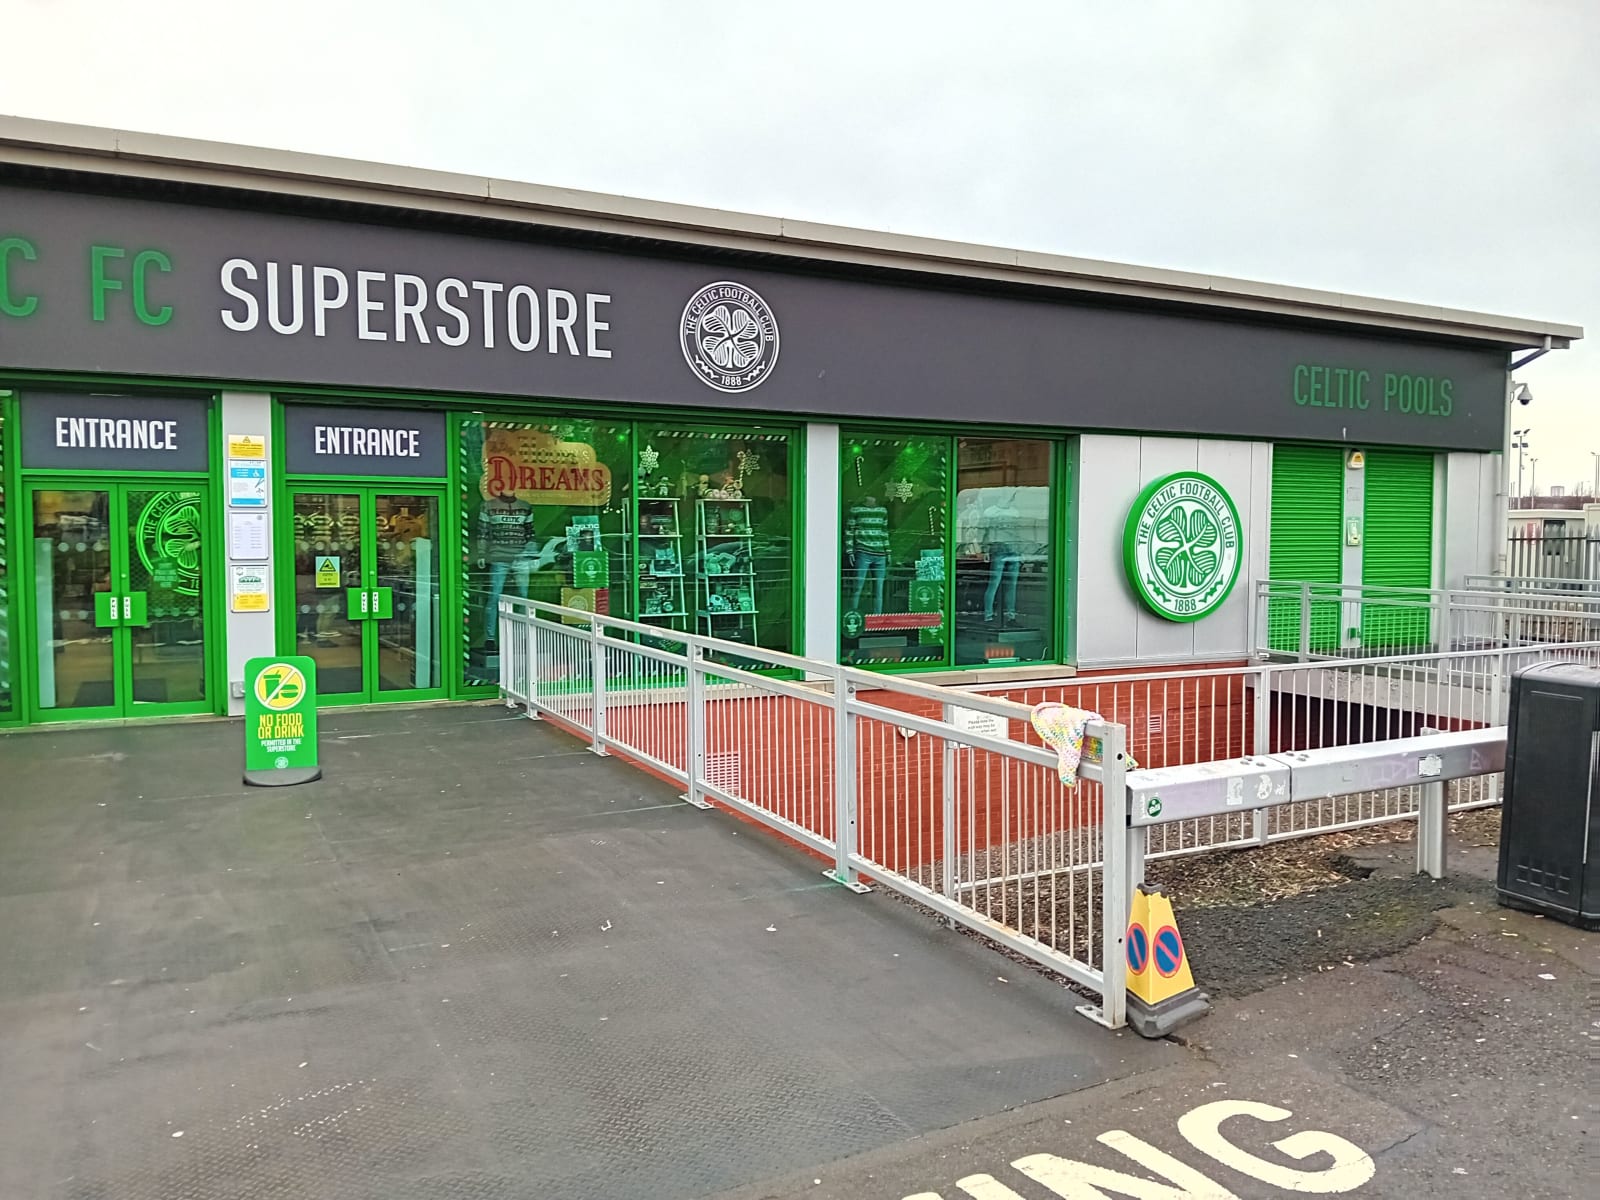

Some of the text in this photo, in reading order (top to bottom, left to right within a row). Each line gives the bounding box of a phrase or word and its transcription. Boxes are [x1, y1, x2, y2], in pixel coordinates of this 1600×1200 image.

[91, 245, 173, 326] FC
[220, 258, 612, 359] SUPERSTORE
[686, 287, 774, 342] THE CELTIC FOOTBALL CLUB
[721, 375, 742, 386] 1888
[1293, 364, 1453, 417] CELTIC POOLS
[55, 417, 178, 450] ENTRANCE
[314, 426, 420, 457] ENTRANCE
[487, 455, 606, 498] DREAMS
[144, 518, 158, 540] THE
[1138, 482, 1235, 549] THE CELTIC FOOTBALL CLUB
[1174, 598, 1197, 612] 1888
[258, 725, 304, 739] OR DRINK
[259, 712, 302, 727] NO FOOD
